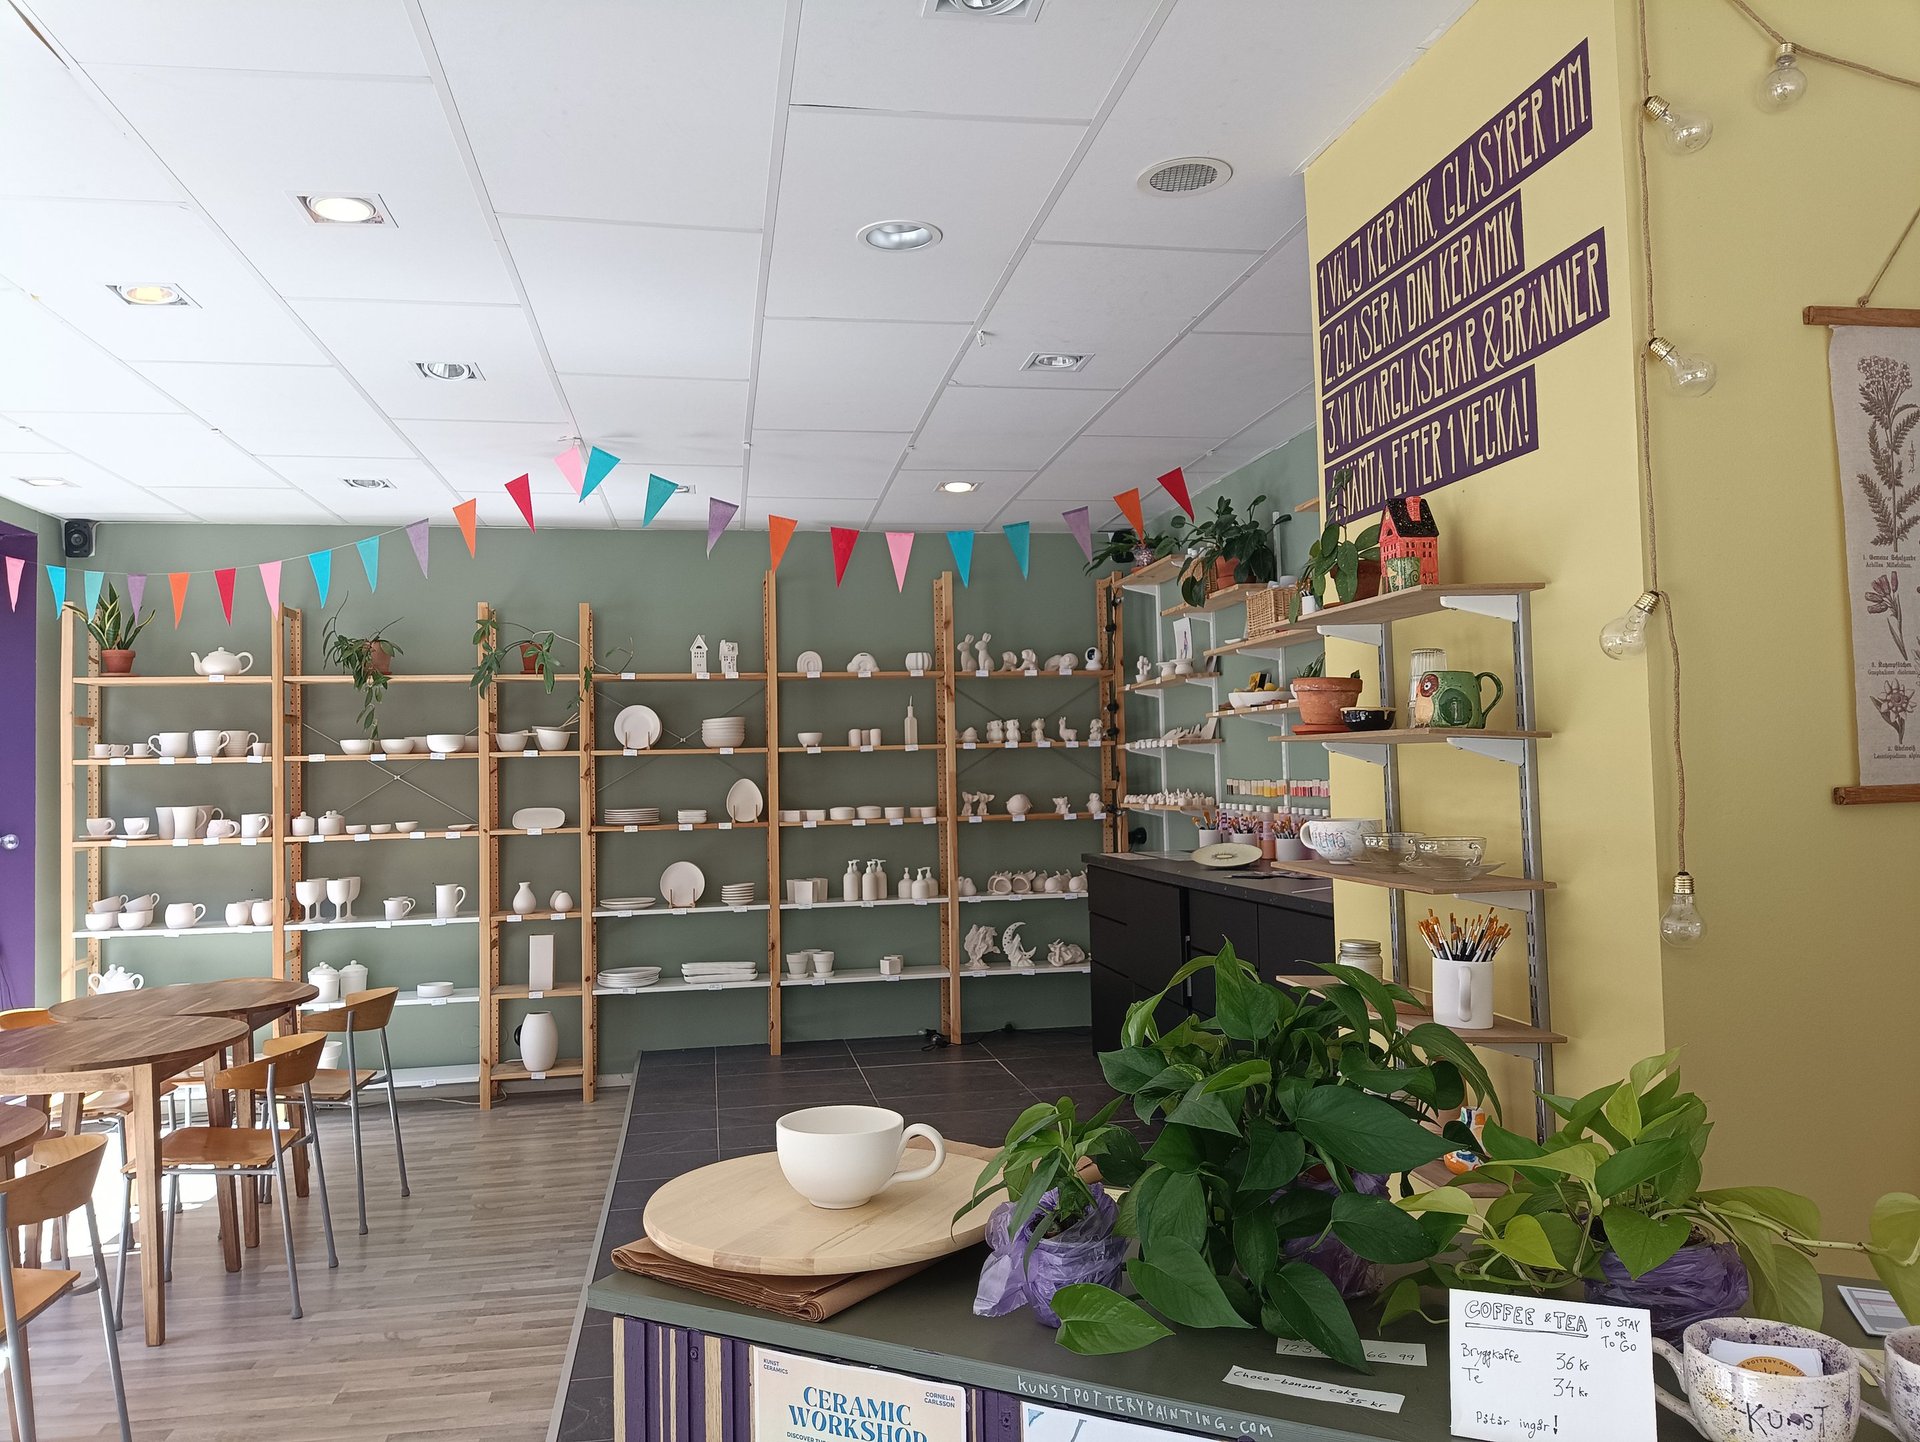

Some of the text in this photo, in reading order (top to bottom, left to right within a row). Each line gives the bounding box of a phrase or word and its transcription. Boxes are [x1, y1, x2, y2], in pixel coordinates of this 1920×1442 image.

[1366, 174, 1438, 282] KERAMIK,
[1440, 86, 1545, 227] GLASYRER
[1405, 259, 1434, 333] DIN
[1439, 200, 1518, 312] KERAMIK
[1354, 316, 1478, 439] KLARGLASERAR
[1391, 419, 1442, 497] EFTER
[1447, 412, 1455, 474] 1
[1458, 376, 1529, 469] VECKA!
[1465, 1300, 1535, 1326] COFFEE
[1617, 1317, 1641, 1332] STAY
[763, 1359, 779, 1367] KUNST
[763, 1365, 788, 1375] CERAMICS
[1461, 1343, 1521, 1367] Bryggkaffe
[1556, 1353, 1574, 1371] 36
[1329, 1389, 1358, 1397] cake
[1462, 1367, 1483, 1384] Te
[1553, 1378, 1574, 1398] 34
[803, 1386, 912, 1426] CERAMIC
[924, 1397, 955, 1408] CARLSSON
[925, 1391, 955, 1402] CORNELIA
[1017, 1375, 1273, 1437] KUNSTPOTTERYPAINTING.COM
[1346, 1397, 1366, 1405] 35
